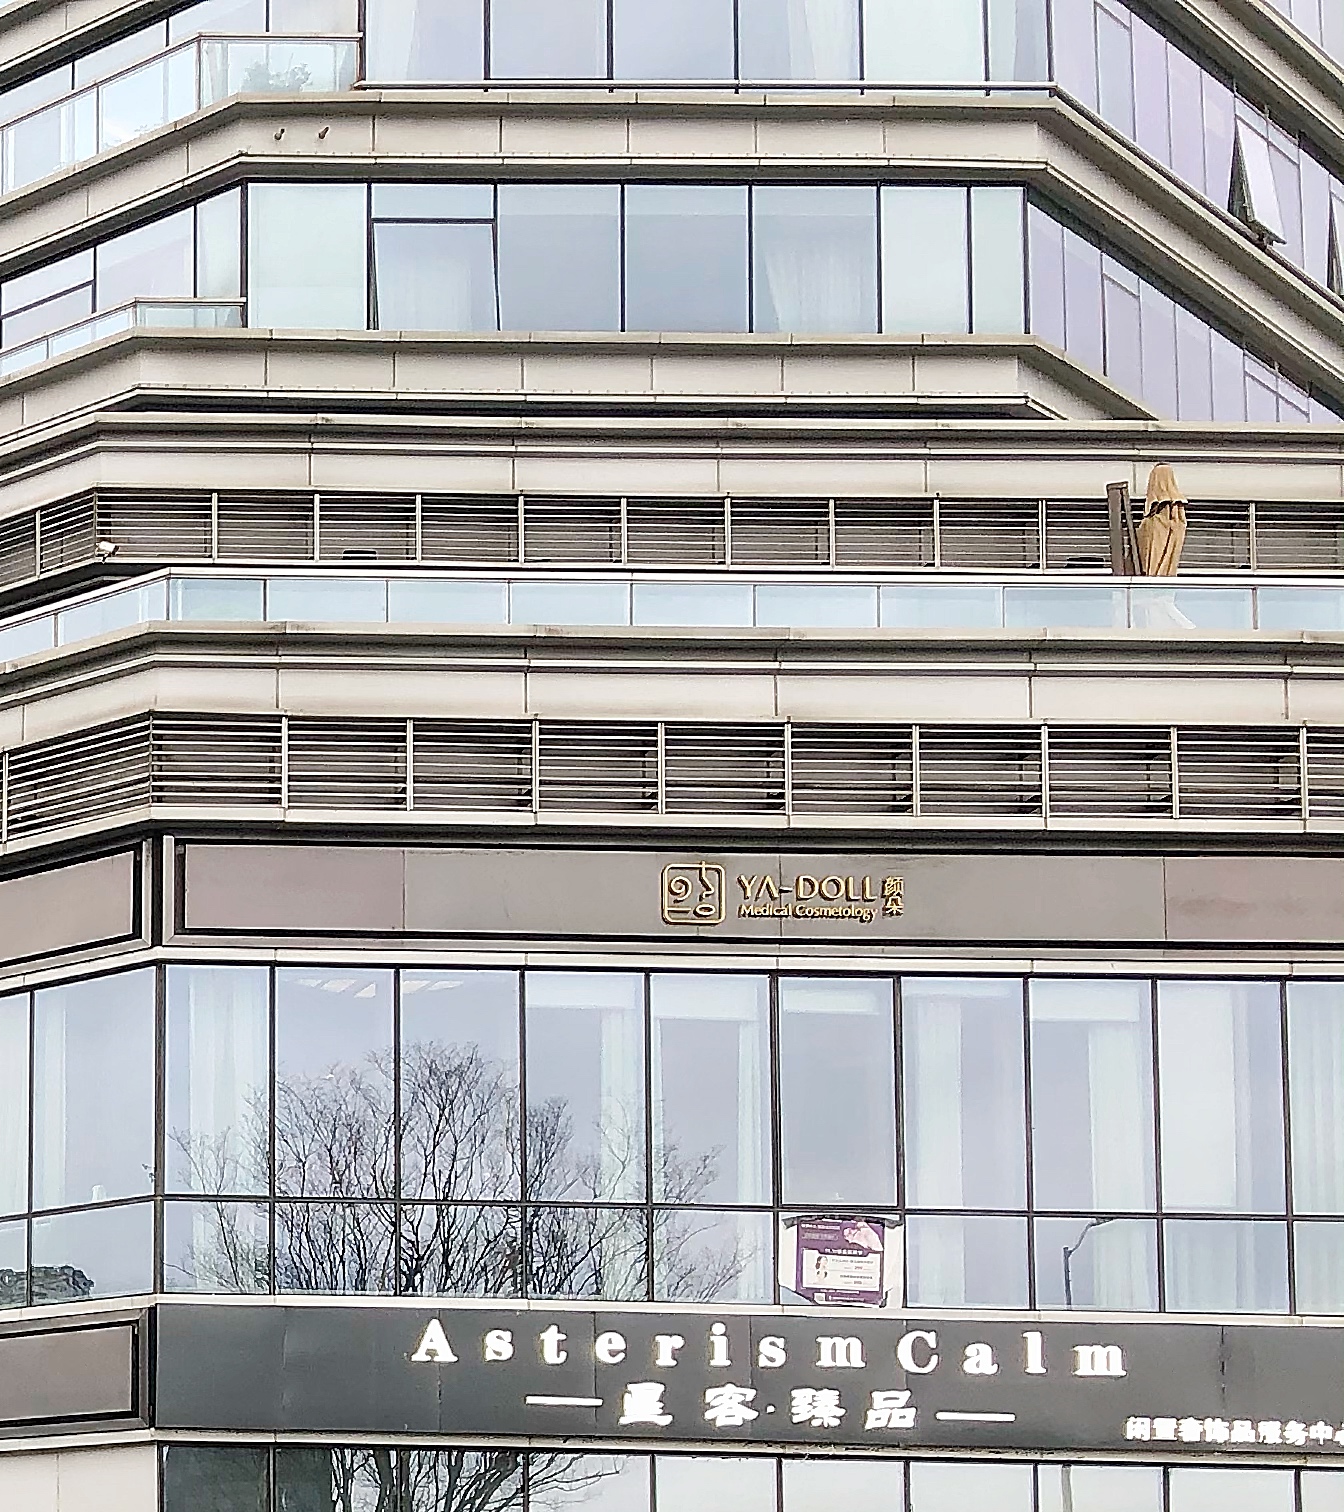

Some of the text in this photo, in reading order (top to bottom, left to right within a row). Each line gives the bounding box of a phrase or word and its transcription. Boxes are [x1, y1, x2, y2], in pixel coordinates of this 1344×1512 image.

[737, 875, 878, 902] YA-DOLL
[739, 903, 878, 923] Medical Cosmetology
